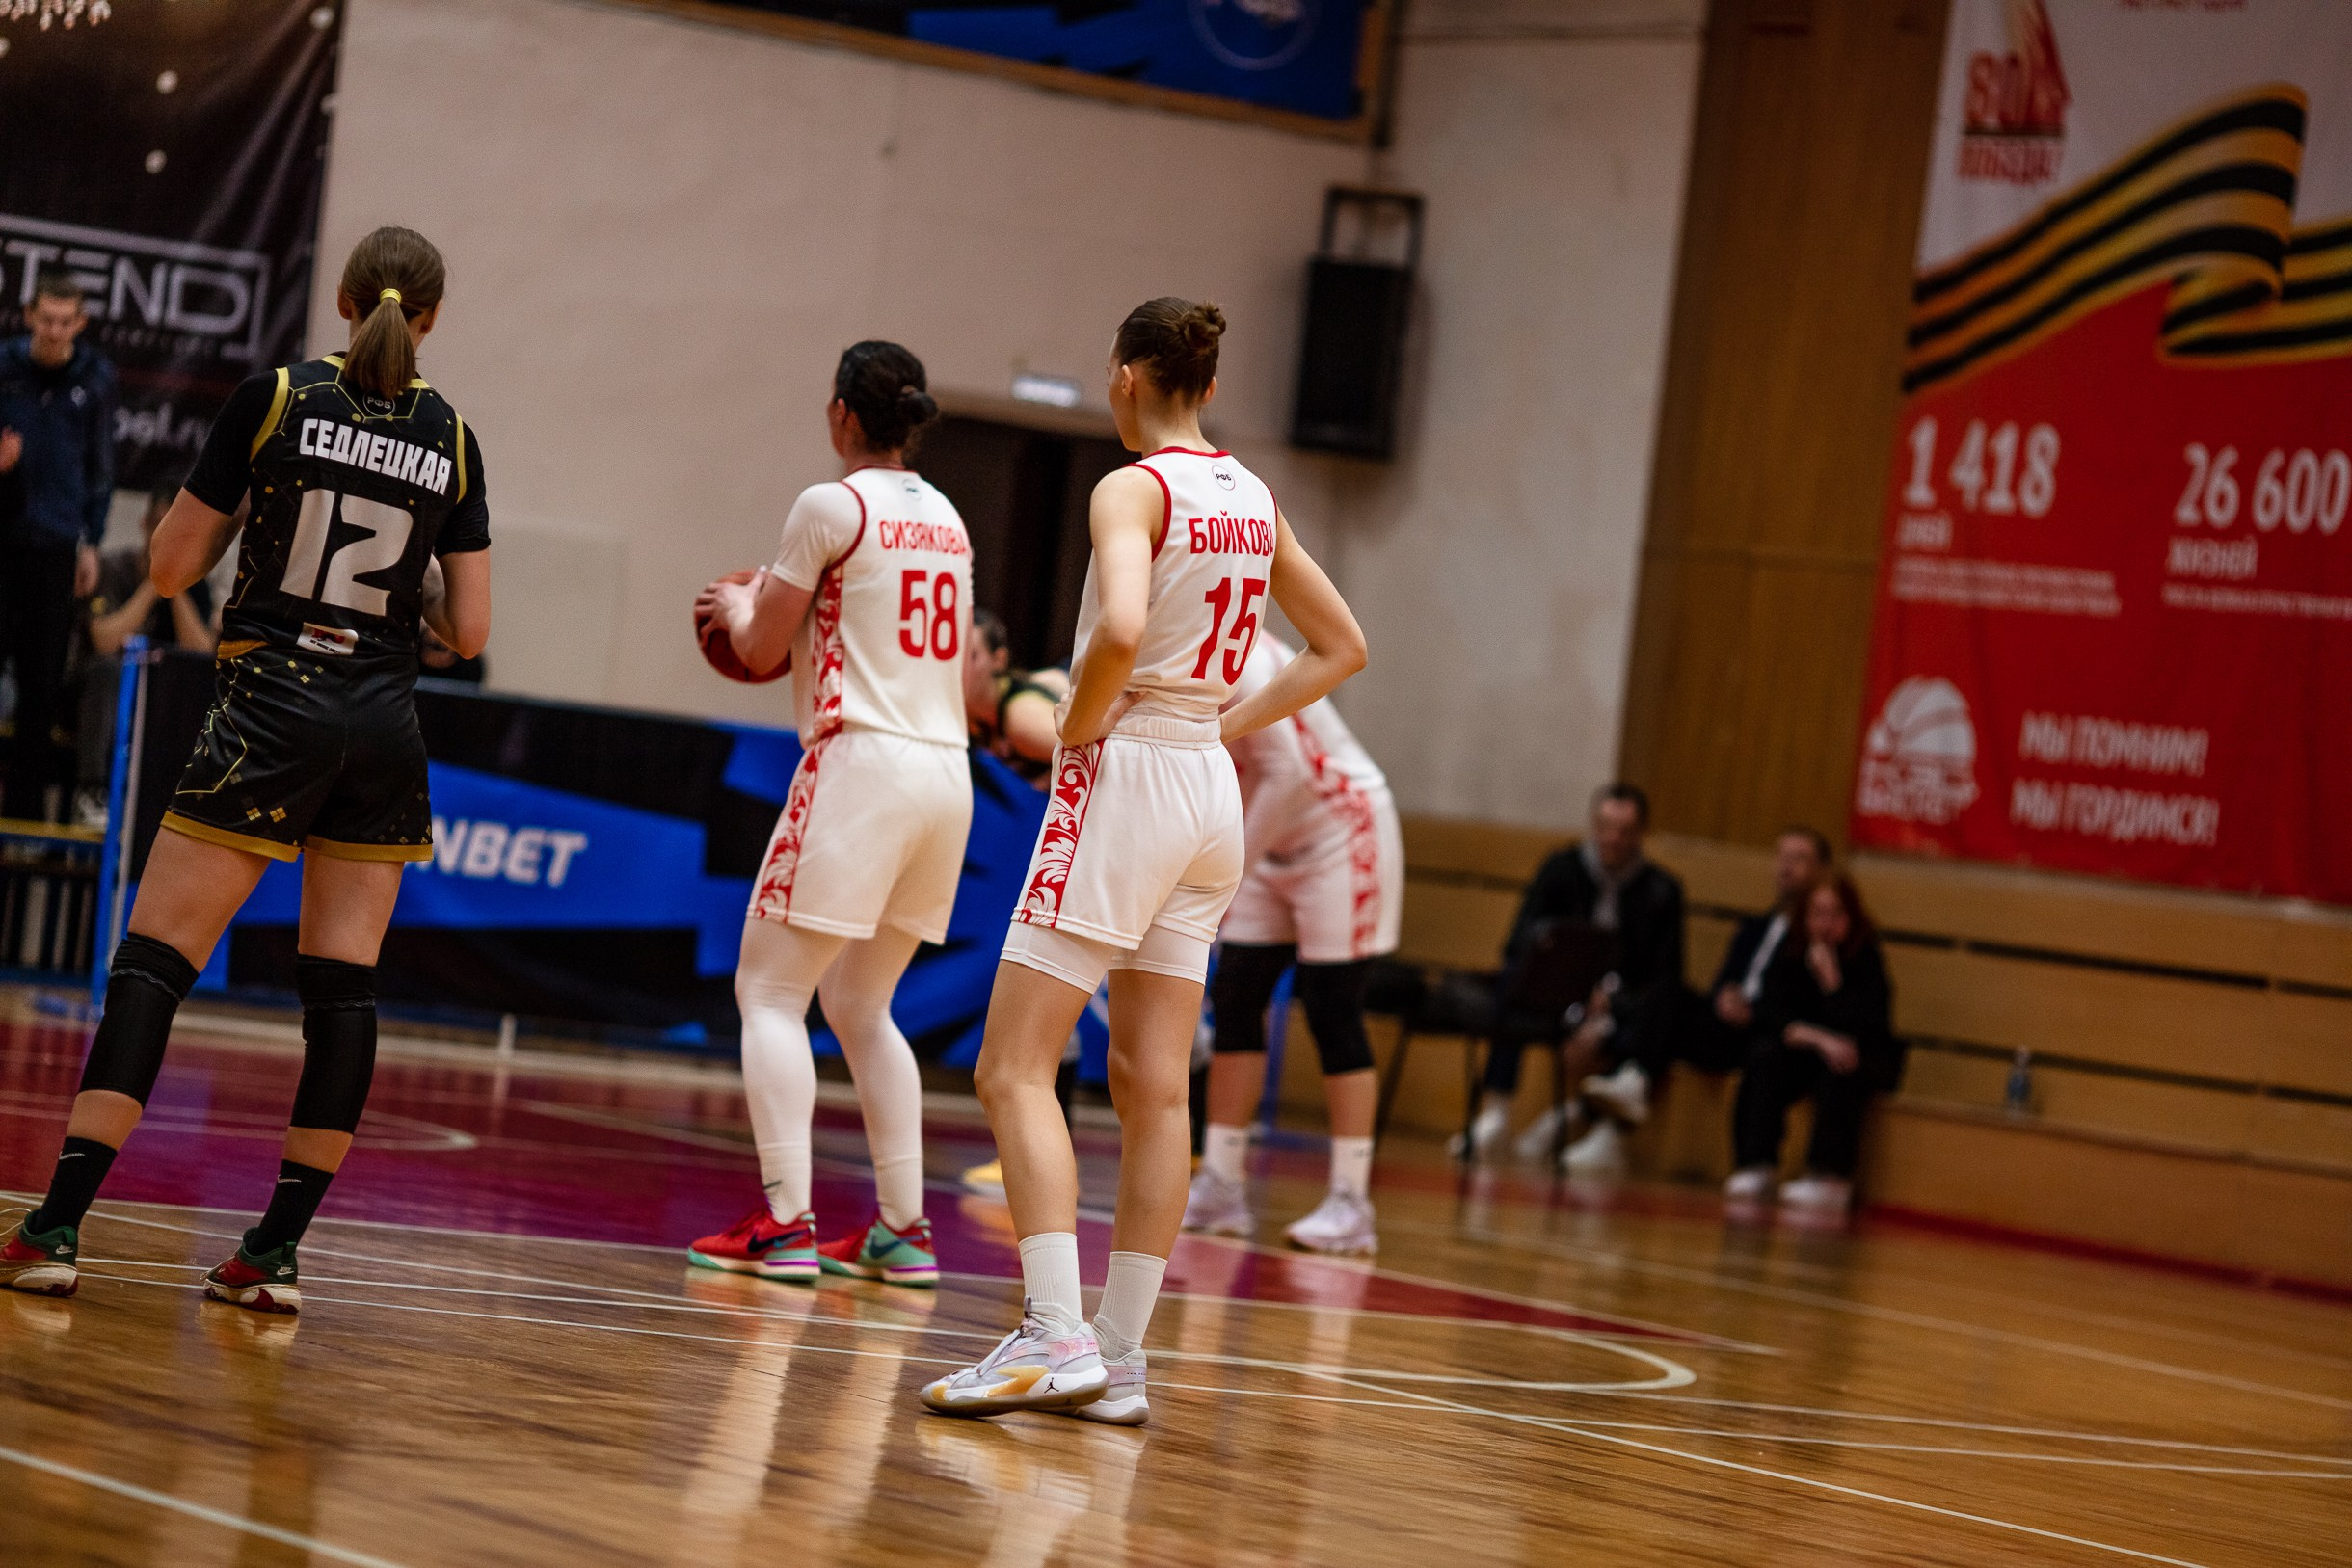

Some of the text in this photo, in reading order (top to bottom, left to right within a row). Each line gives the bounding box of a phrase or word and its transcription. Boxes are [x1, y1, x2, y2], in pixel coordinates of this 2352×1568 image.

[0, 242, 251, 334] TEND
[367, 397, 391, 410] РФБ
[299, 418, 452, 496] СЕДЛЕЦКАЯ
[1903, 415, 2061, 518] 1 418
[2174, 441, 2352, 536] 26 600
[279, 488, 414, 617] 12
[879, 520, 966, 555] СИЗЯКОВА
[899, 570, 958, 661] 58
[1190, 577, 1267, 686] 15
[405, 816, 587, 888] NBET
